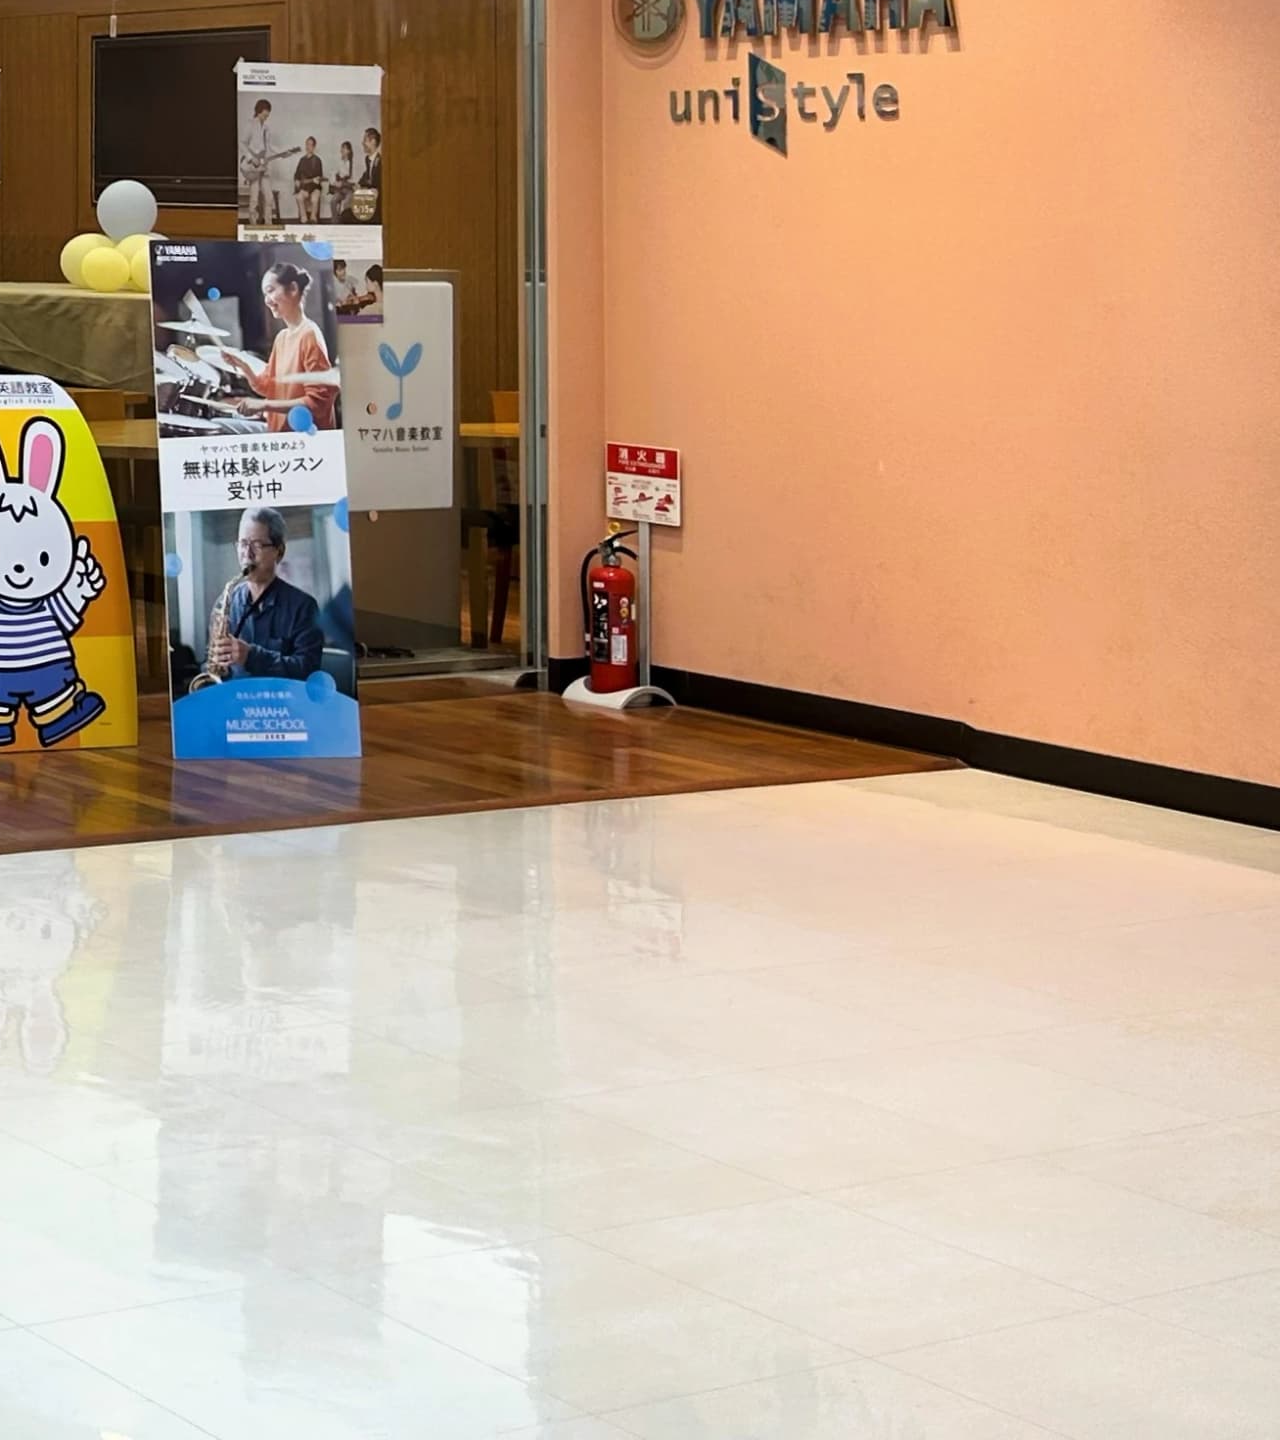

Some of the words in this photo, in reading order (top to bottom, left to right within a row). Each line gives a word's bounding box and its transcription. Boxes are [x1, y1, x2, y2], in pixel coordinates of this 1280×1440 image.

[669, 71, 901, 132] uniStyle
[358, 427, 443, 441] ヤマハ音楽教室
[182, 457, 325, 480] 無料体験レッスン
[227, 478, 283, 502] 受付中
[243, 707, 289, 717] YAMAHA
[226, 720, 261, 730] MUSIC
[263, 719, 307, 730] SCHOOL
